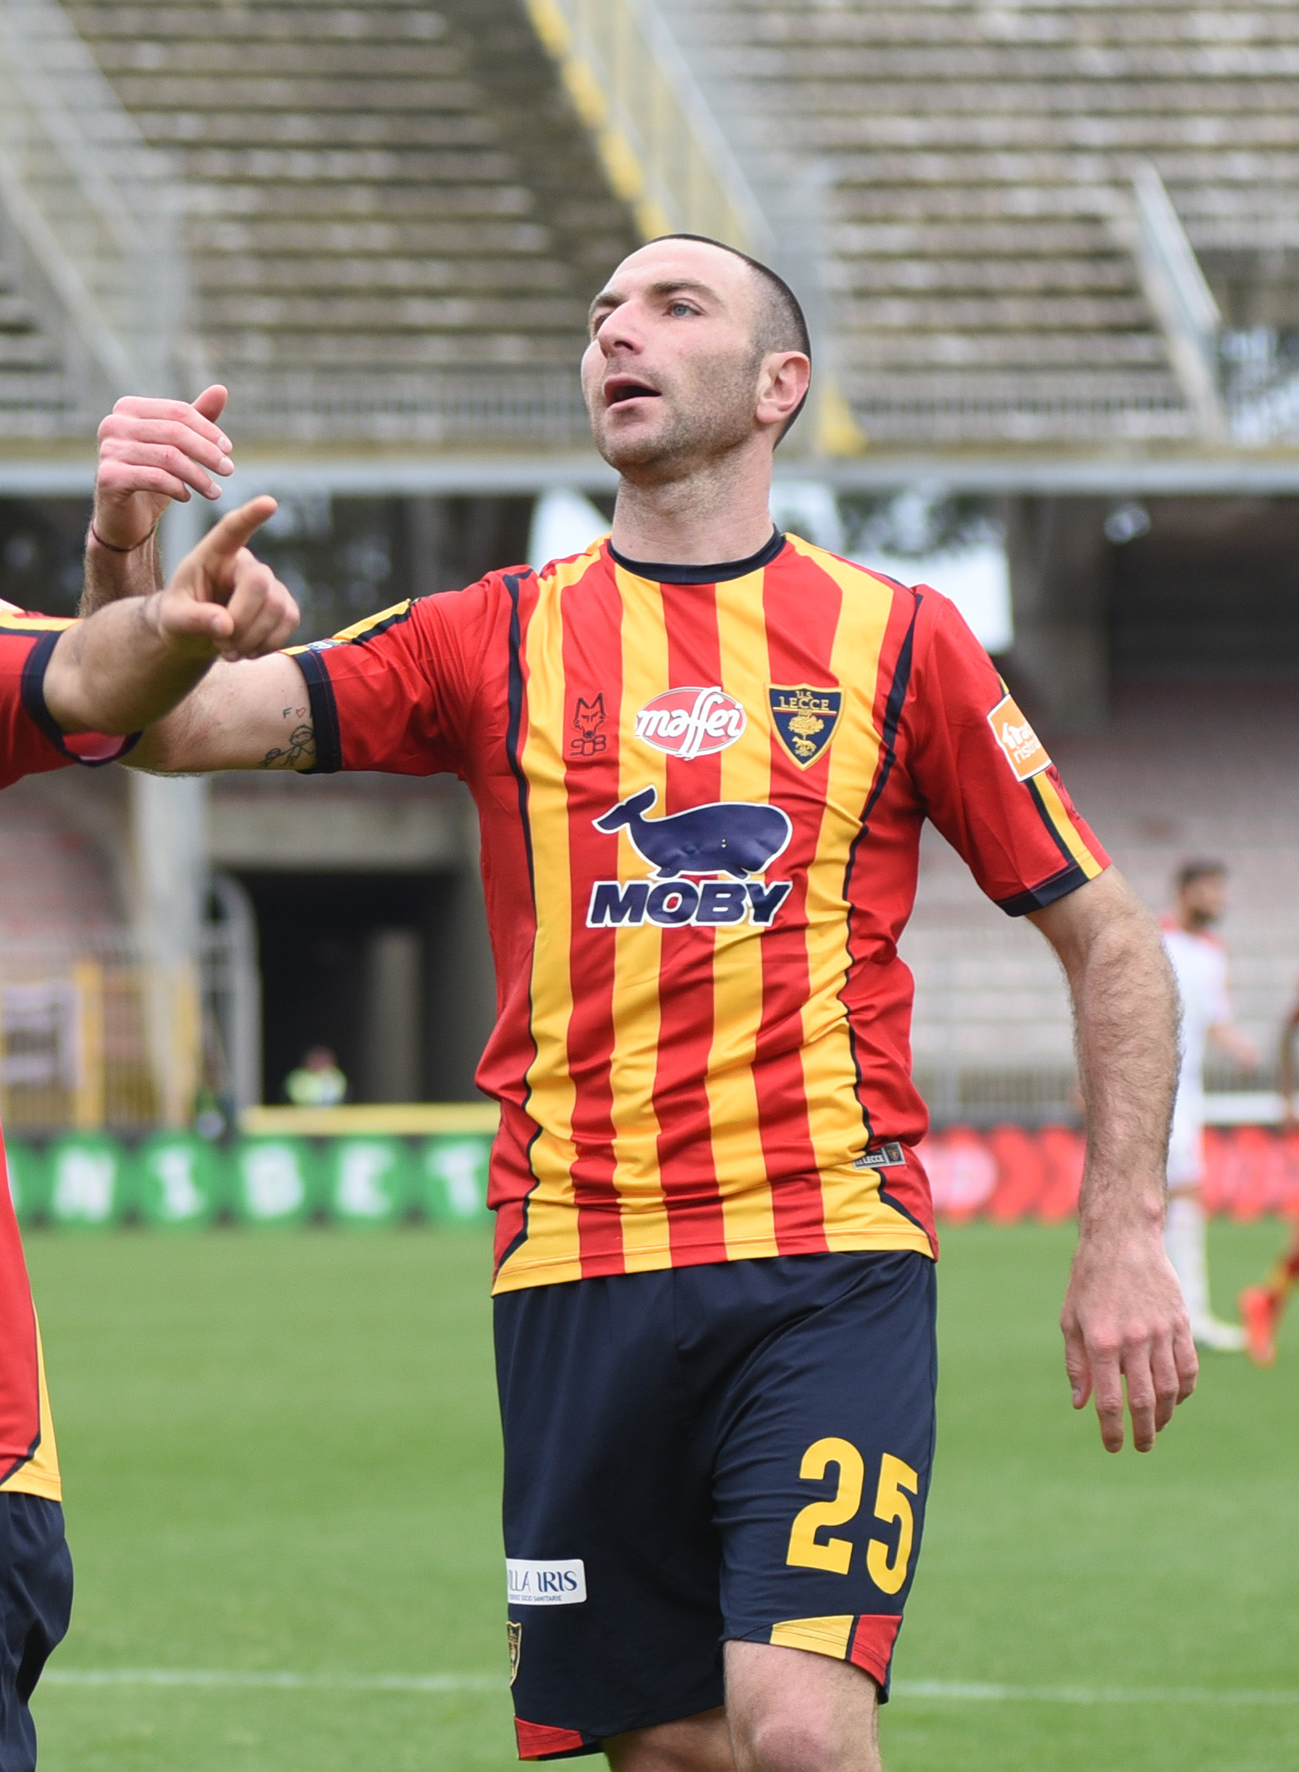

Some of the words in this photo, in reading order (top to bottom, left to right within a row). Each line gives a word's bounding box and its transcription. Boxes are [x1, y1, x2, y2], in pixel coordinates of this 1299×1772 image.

[635, 686, 744, 760] maffei
[779, 696, 829, 711] LECCE
[586, 880, 793, 928] MOBY
[786, 1436, 918, 1595] 25
[537, 1570, 578, 1592] IRIS
